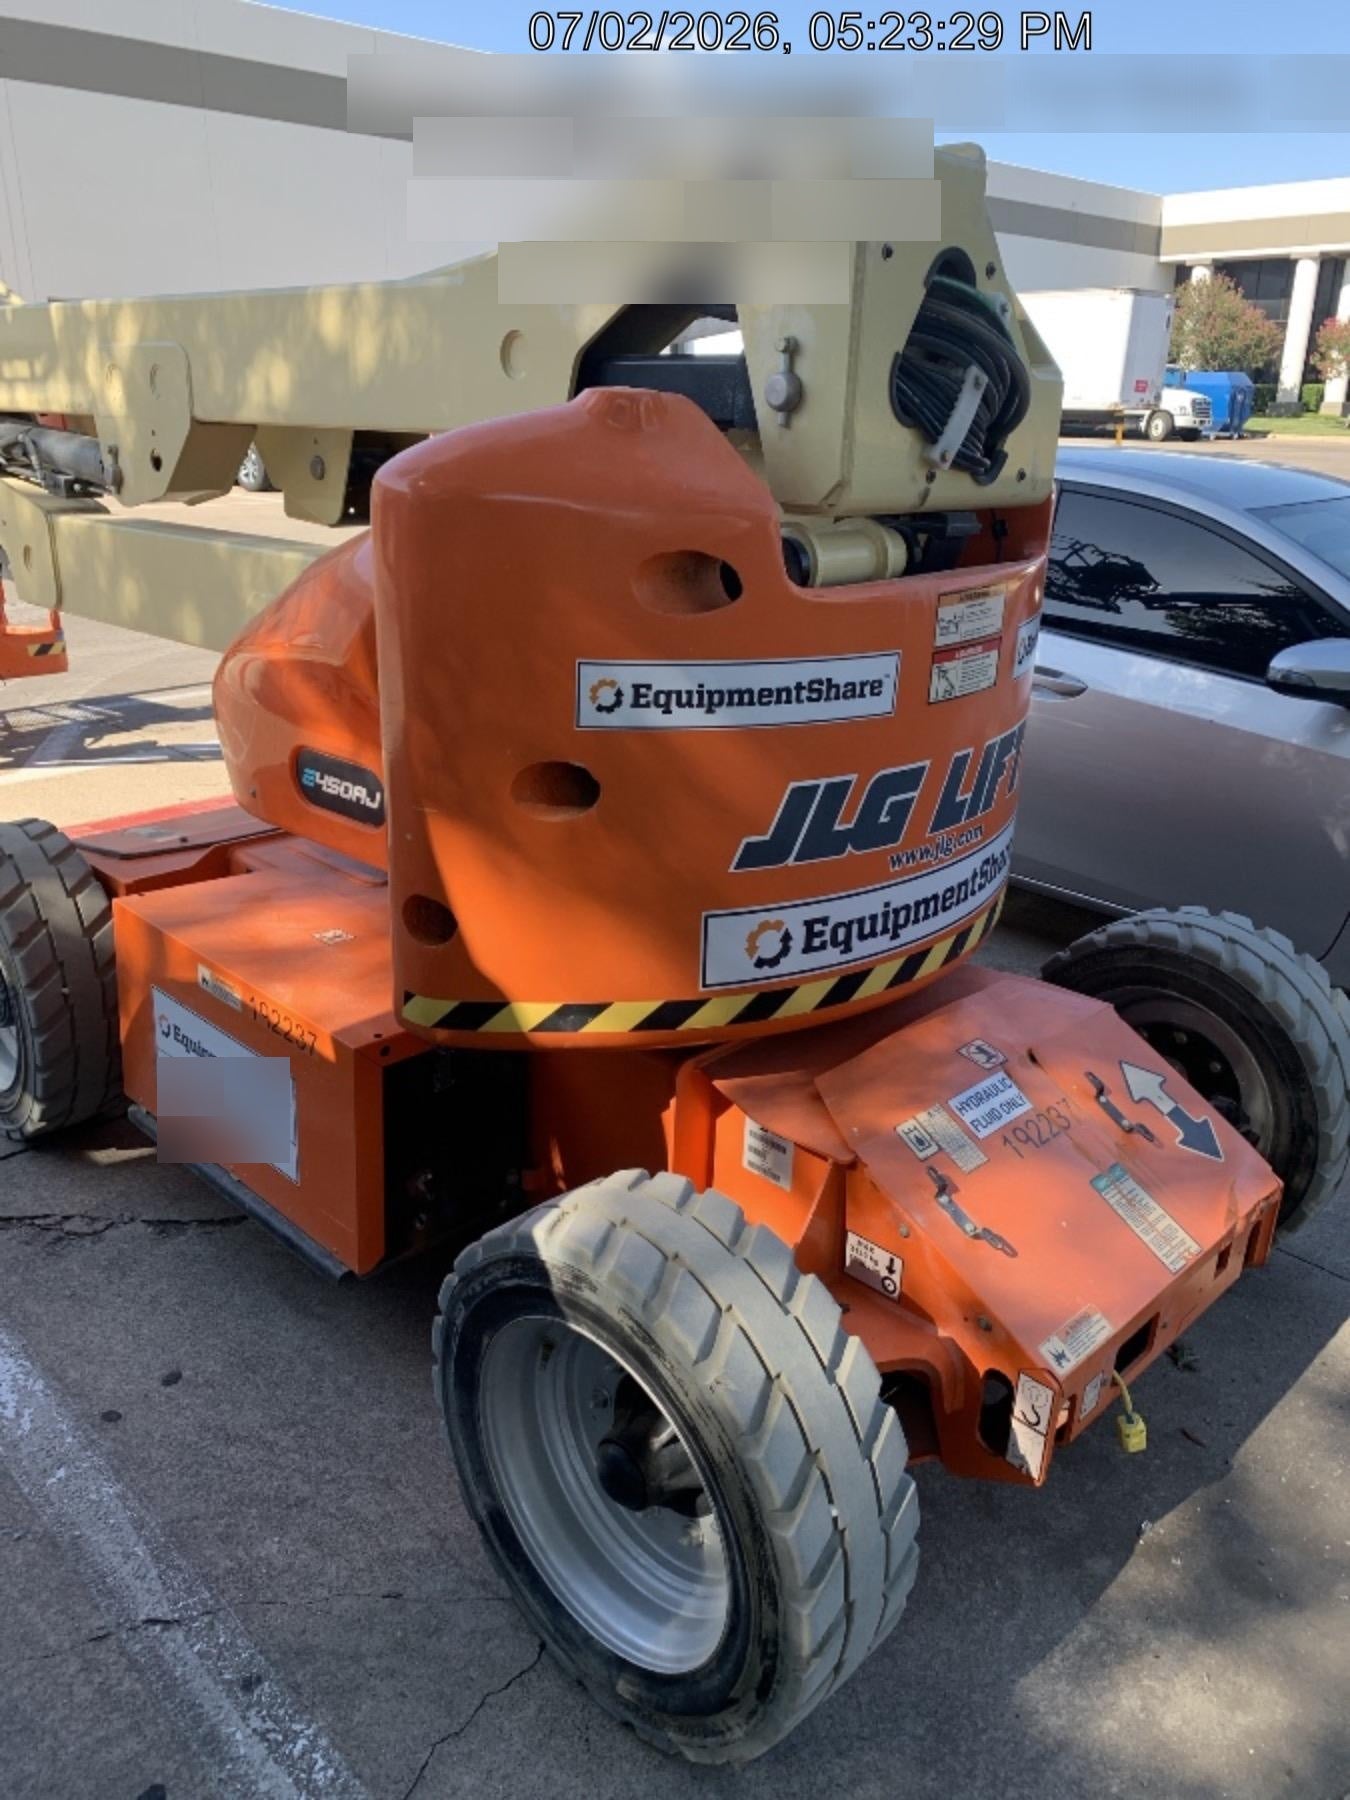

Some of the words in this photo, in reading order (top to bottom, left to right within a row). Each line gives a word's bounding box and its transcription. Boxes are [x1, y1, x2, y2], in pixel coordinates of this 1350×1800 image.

[630, 677, 883, 714] EquipmentShare
[728, 761, 930, 873] JLG
[888, 824, 984, 872] www.jlg.com
[955, 1077, 1013, 1117] HYDRAULIC
[969, 1107, 1003, 1133] FLUID
[1000, 1092, 1027, 1115] ONLY
